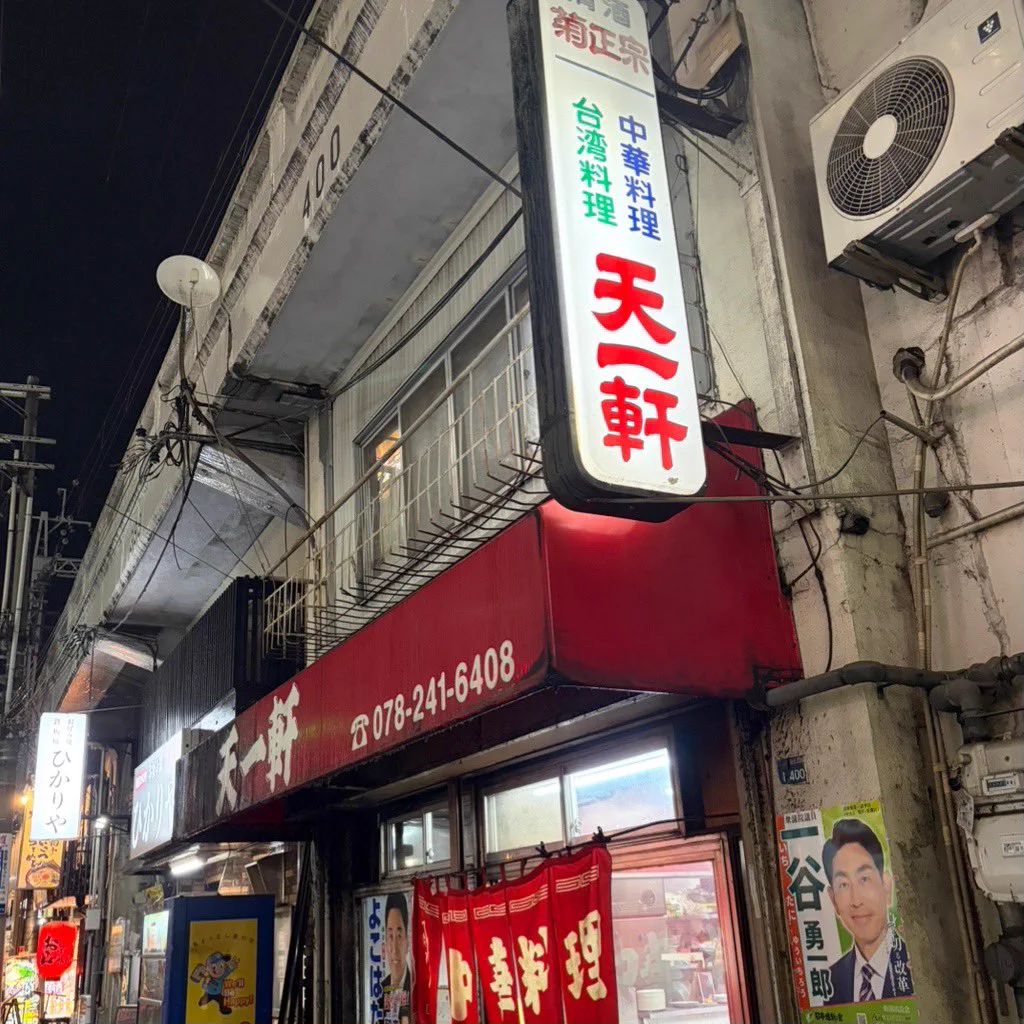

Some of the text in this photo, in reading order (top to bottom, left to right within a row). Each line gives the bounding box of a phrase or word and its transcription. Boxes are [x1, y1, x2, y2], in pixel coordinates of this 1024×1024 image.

[550, 5, 650, 76] 菊正宗
[572, 96, 618, 228] 台湾料理
[617, 114, 662, 243] 中華料理
[592, 251, 689, 471] 天一軒
[215, 681, 300, 817] 天一軒
[373, 639, 515, 741] 078-241-6408
[45, 749, 72, 834] ひかりや
